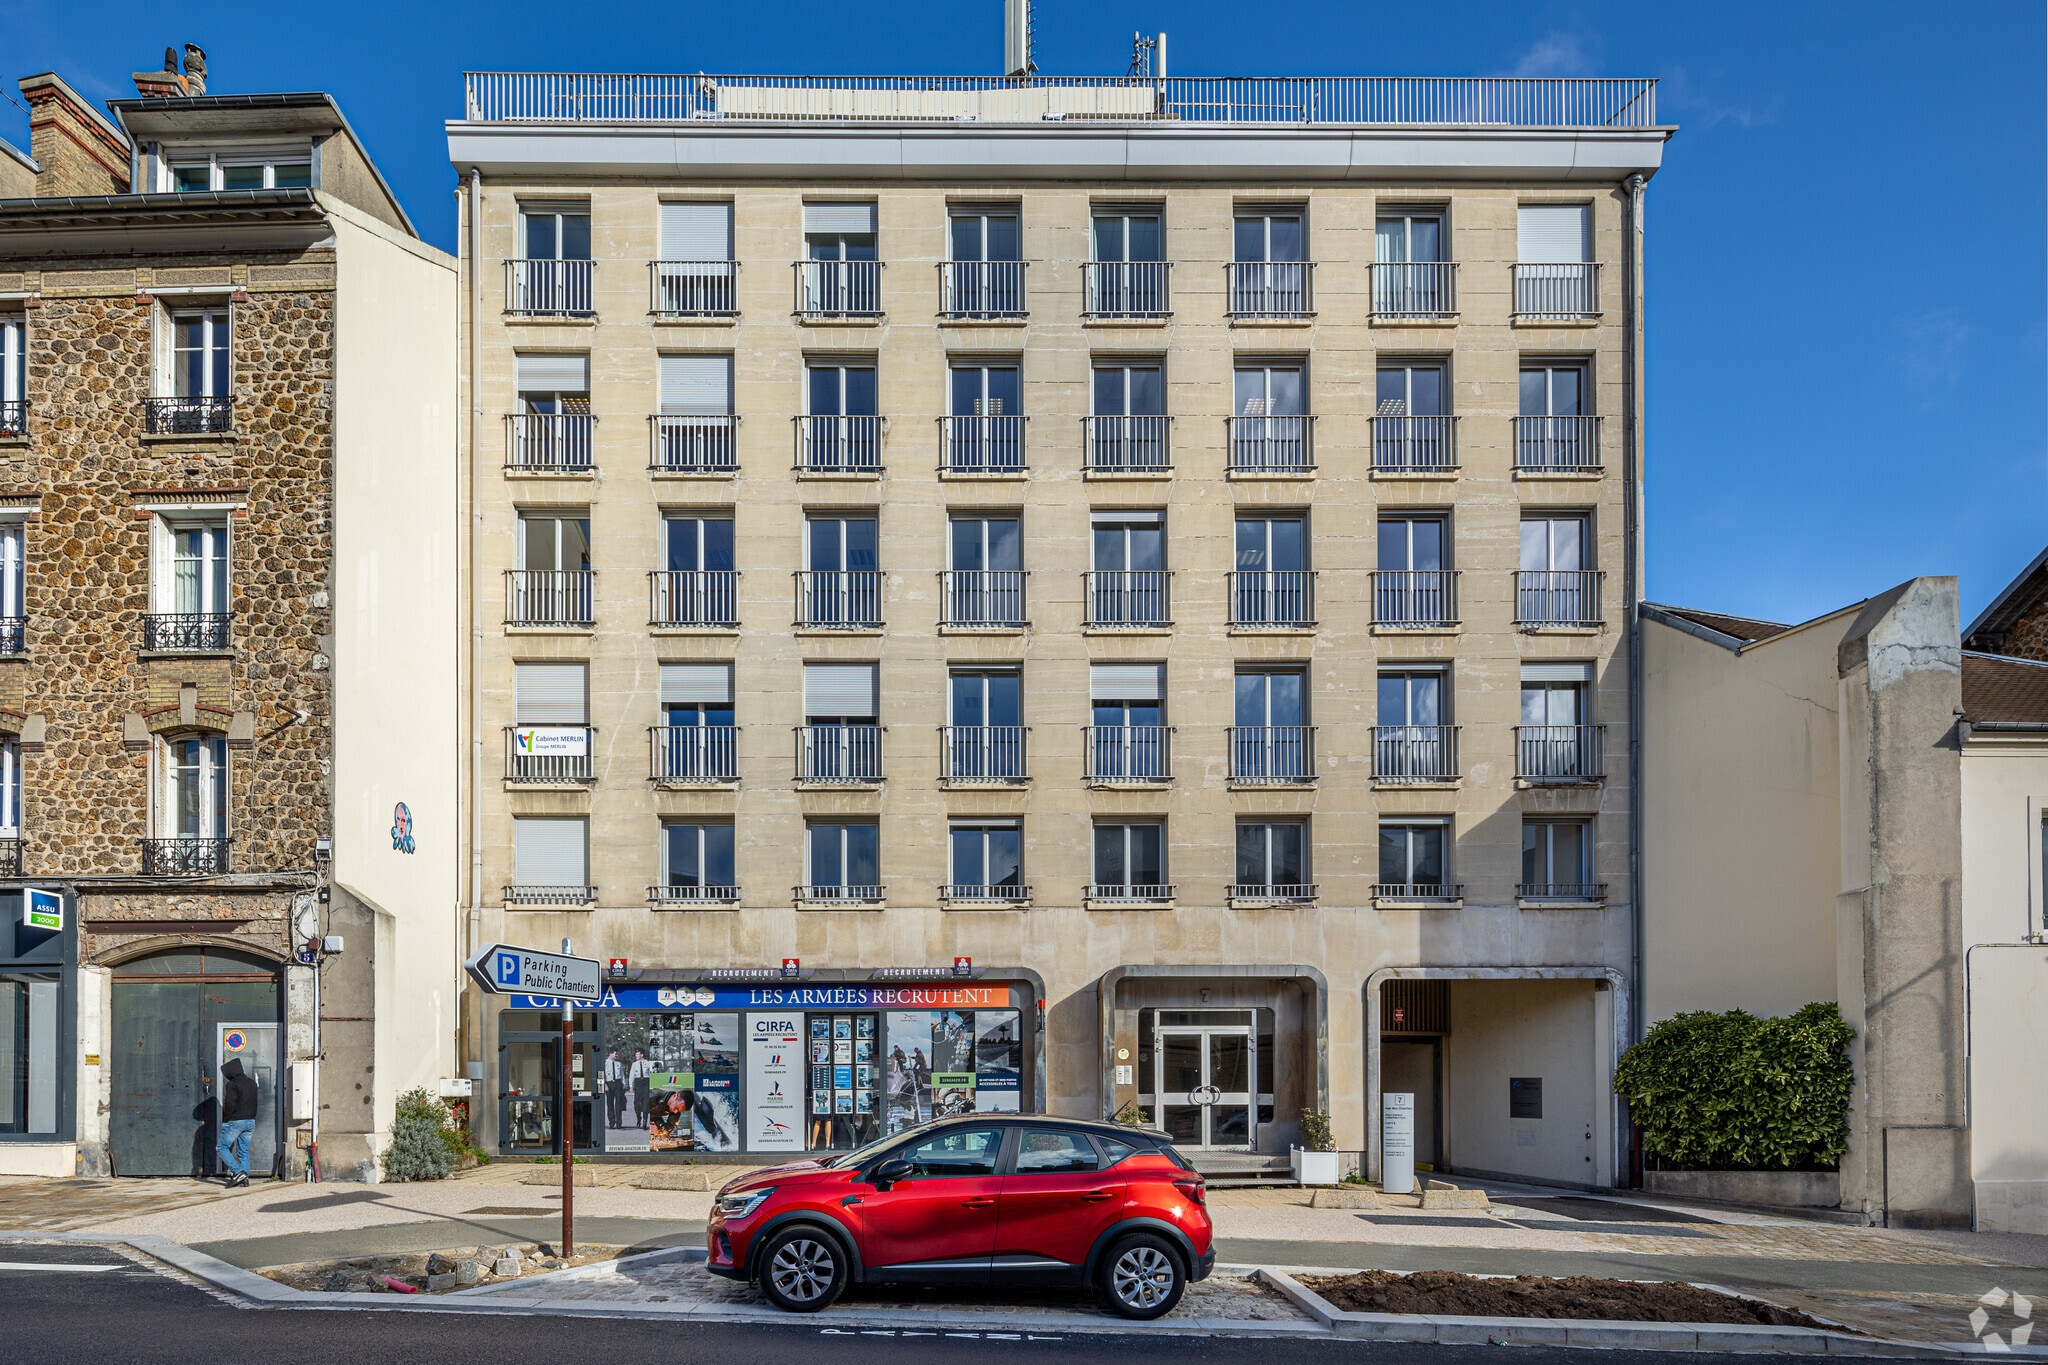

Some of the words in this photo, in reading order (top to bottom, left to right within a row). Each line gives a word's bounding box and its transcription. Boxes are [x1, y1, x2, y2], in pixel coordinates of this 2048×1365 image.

[36, 904, 56, 912] ASSU
[36, 916, 55, 924] 2000
[502, 956, 516, 981] P
[524, 957, 568, 978] Parking
[524, 974, 552, 989] Public
[556, 978, 595, 994] Chantiers
[750, 989, 782, 1004] LES
[787, 986, 868, 1004] ARMÉES
[872, 988, 992, 1004] RECRUTENT
[756, 1021, 794, 1032] CIRFA
